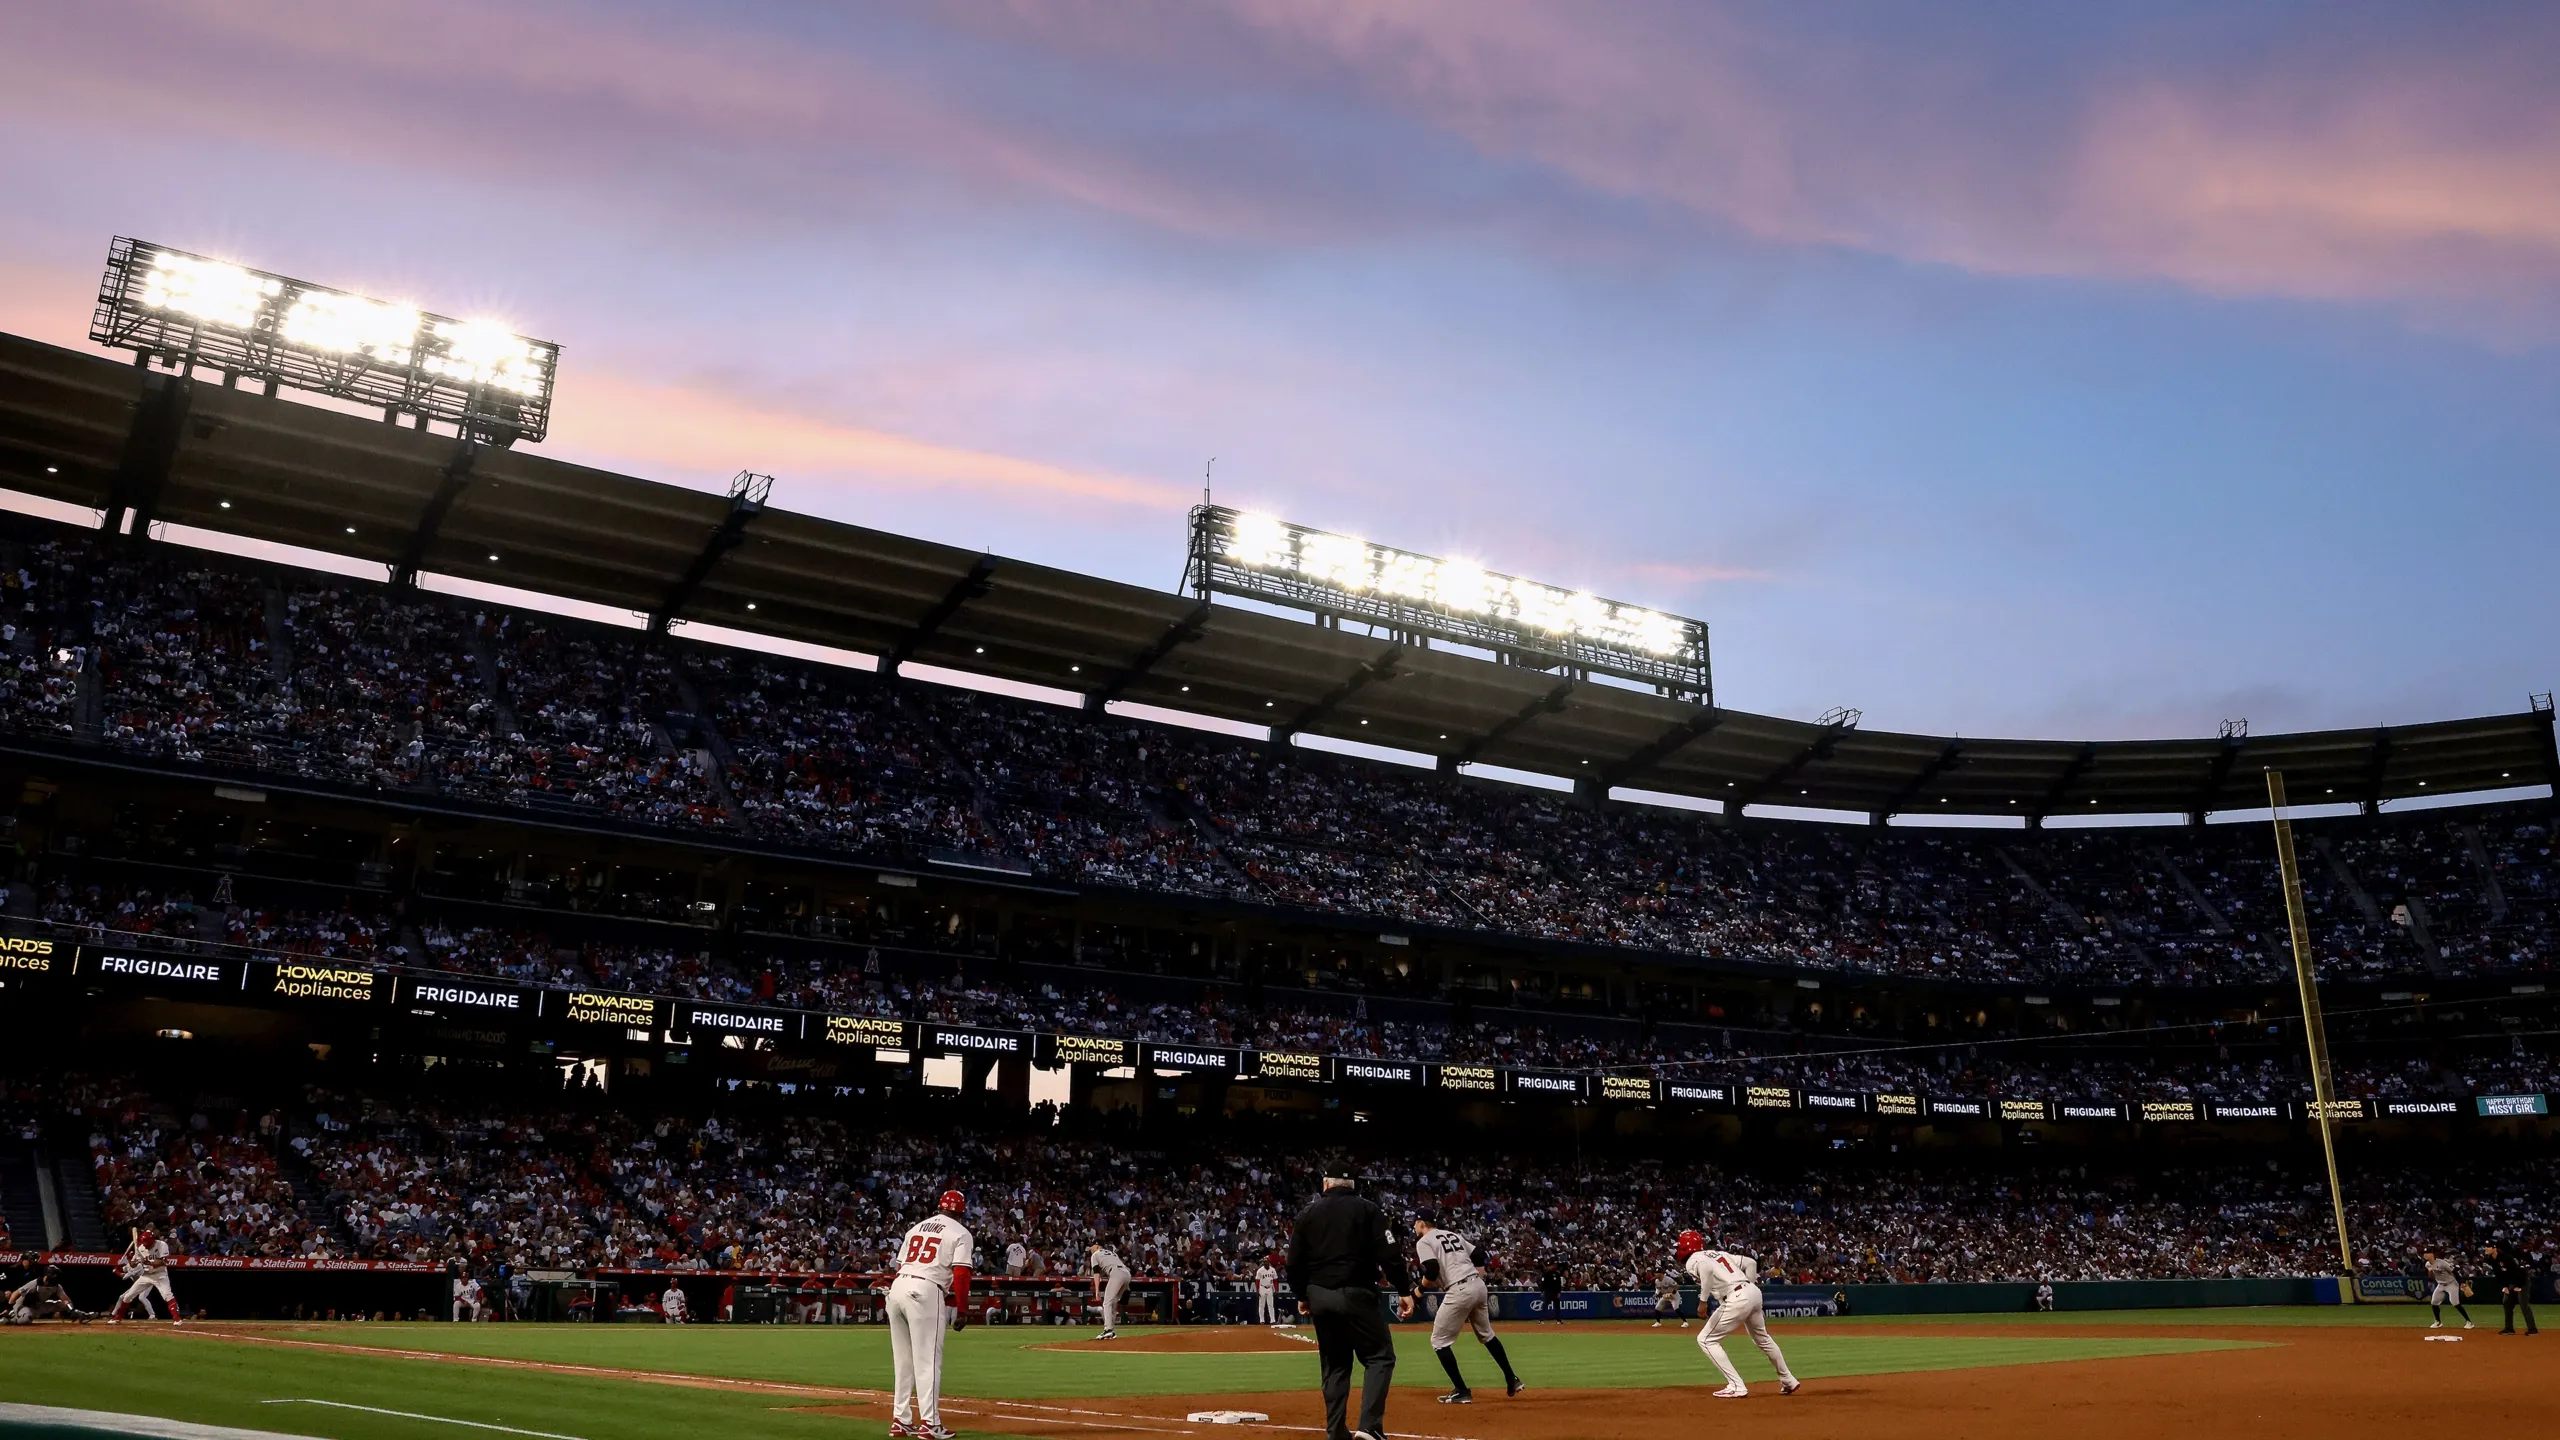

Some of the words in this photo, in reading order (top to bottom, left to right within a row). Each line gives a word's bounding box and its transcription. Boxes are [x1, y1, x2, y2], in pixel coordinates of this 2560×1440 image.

[0, 955, 50, 970] ances
[102, 957, 219, 980] FRIGIDAIRE
[274, 979, 371, 1000] Appliances
[416, 986, 519, 1007] FRIGIDAIRE
[567, 1006, 652, 1025] Appliances
[692, 1012, 783, 1031] FRIGIDAIRE
[826, 1029, 901, 1048] Appliances
[937, 1033, 1017, 1050] FRIGIDAIRE
[1056, 1048, 1123, 1066] Appliances
[1154, 1051, 1225, 1066] FRIGIDAIRE
[1260, 1064, 1319, 1078] Appliances
[1347, 1065, 1411, 1080] FRIGIDAIRE
[1441, 1077, 1494, 1089] Appliances
[1519, 1077, 1575, 1090] FRIGIDAIRE
[1603, 1087, 1650, 1099] Appliances
[1672, 1087, 1723, 1099] FRIGIDAIRE
[1748, 1096, 1790, 1107] Appliances
[1809, 1096, 1855, 1107] FRIGIDAIRE
[1934, 1103, 1980, 1113] FRIGIDAIRE
[2389, 1103, 2456, 1113] FRIGIDAIRE
[2486, 1098, 2505, 1106] HAPPY
[2506, 1097, 2535, 1105] BIRTHDAY
[1878, 1104, 1916, 1114] Appliances
[2002, 1110, 2044, 1120] Appliances
[2064, 1108, 2116, 1116] FRIGIDAIRE
[2216, 1107, 2277, 1116] FRIGIDAIRE
[2488, 1104, 2513, 1114] MISSY
[2515, 1104, 2536, 1113] GIRL
[2144, 1112, 2194, 1121] Appliances
[919, 1222, 946, 1234] YOUNG
[905, 1235, 942, 1264] 85
[1436, 1233, 1464, 1253] 22
[1716, 1256, 1734, 1273] 7
[2361, 1278, 2403, 1288] Contact
[2407, 1279, 2425, 1292] 811
[1547, 1300, 1588, 1310] HUNDAI
